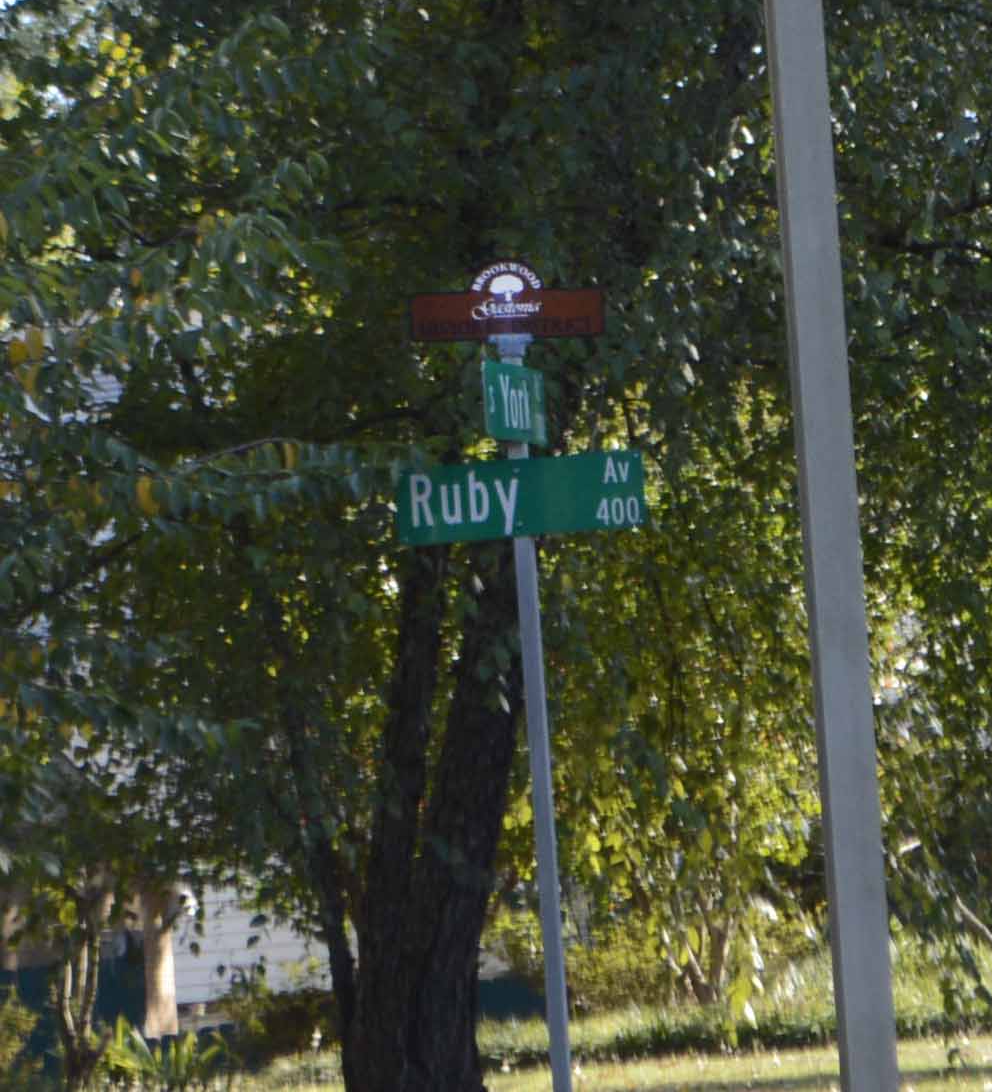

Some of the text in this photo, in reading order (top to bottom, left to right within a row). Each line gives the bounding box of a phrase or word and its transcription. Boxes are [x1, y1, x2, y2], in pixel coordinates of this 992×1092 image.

[472, 263, 541, 291] BROOKWOOD
[603, 457, 629, 485] Av
[409, 470, 519, 537] Ruby
[595, 496, 640, 525] 400
